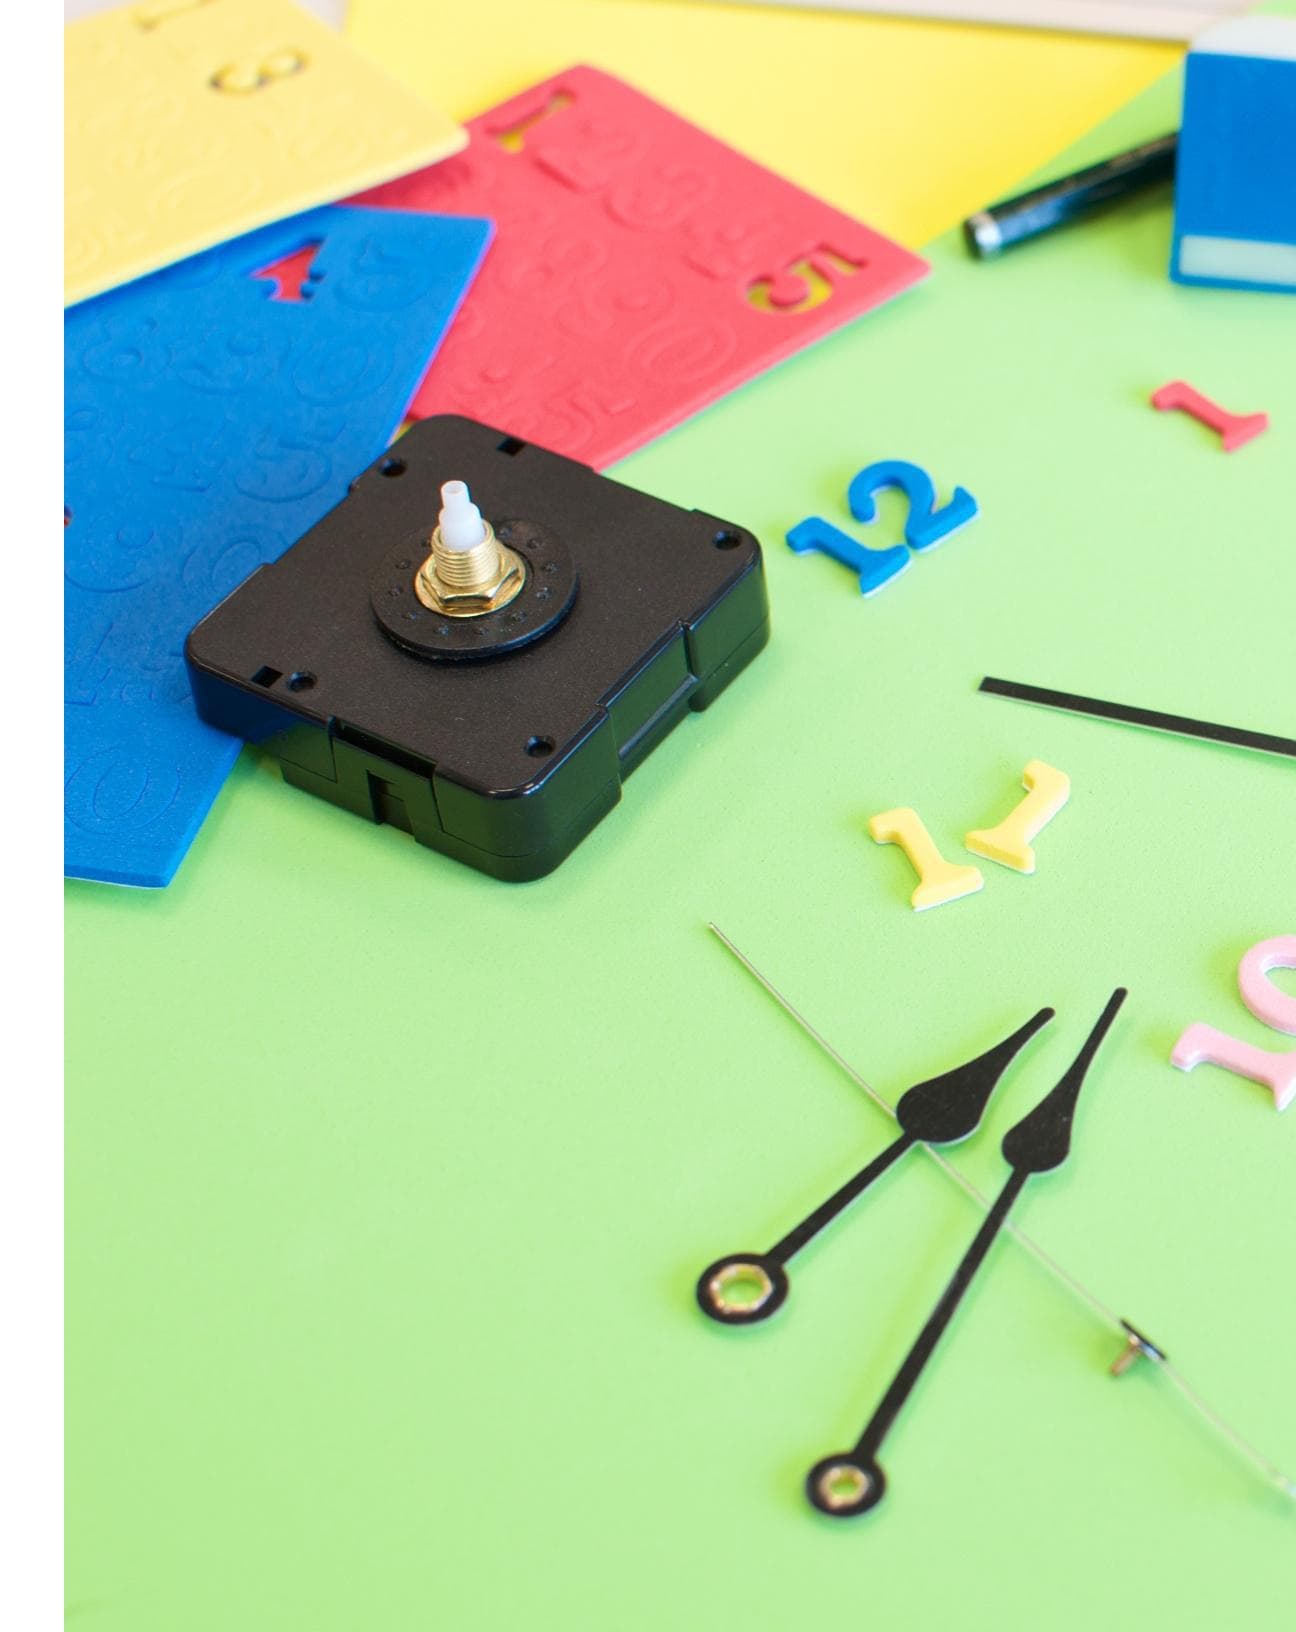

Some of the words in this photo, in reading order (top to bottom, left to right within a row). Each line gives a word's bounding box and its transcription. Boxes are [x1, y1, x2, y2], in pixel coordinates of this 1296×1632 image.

[208, 47, 312, 98] 3
[745, 241, 868, 314] 5
[1146, 377, 1271, 455] 1
[786, 459, 980, 597] 12
